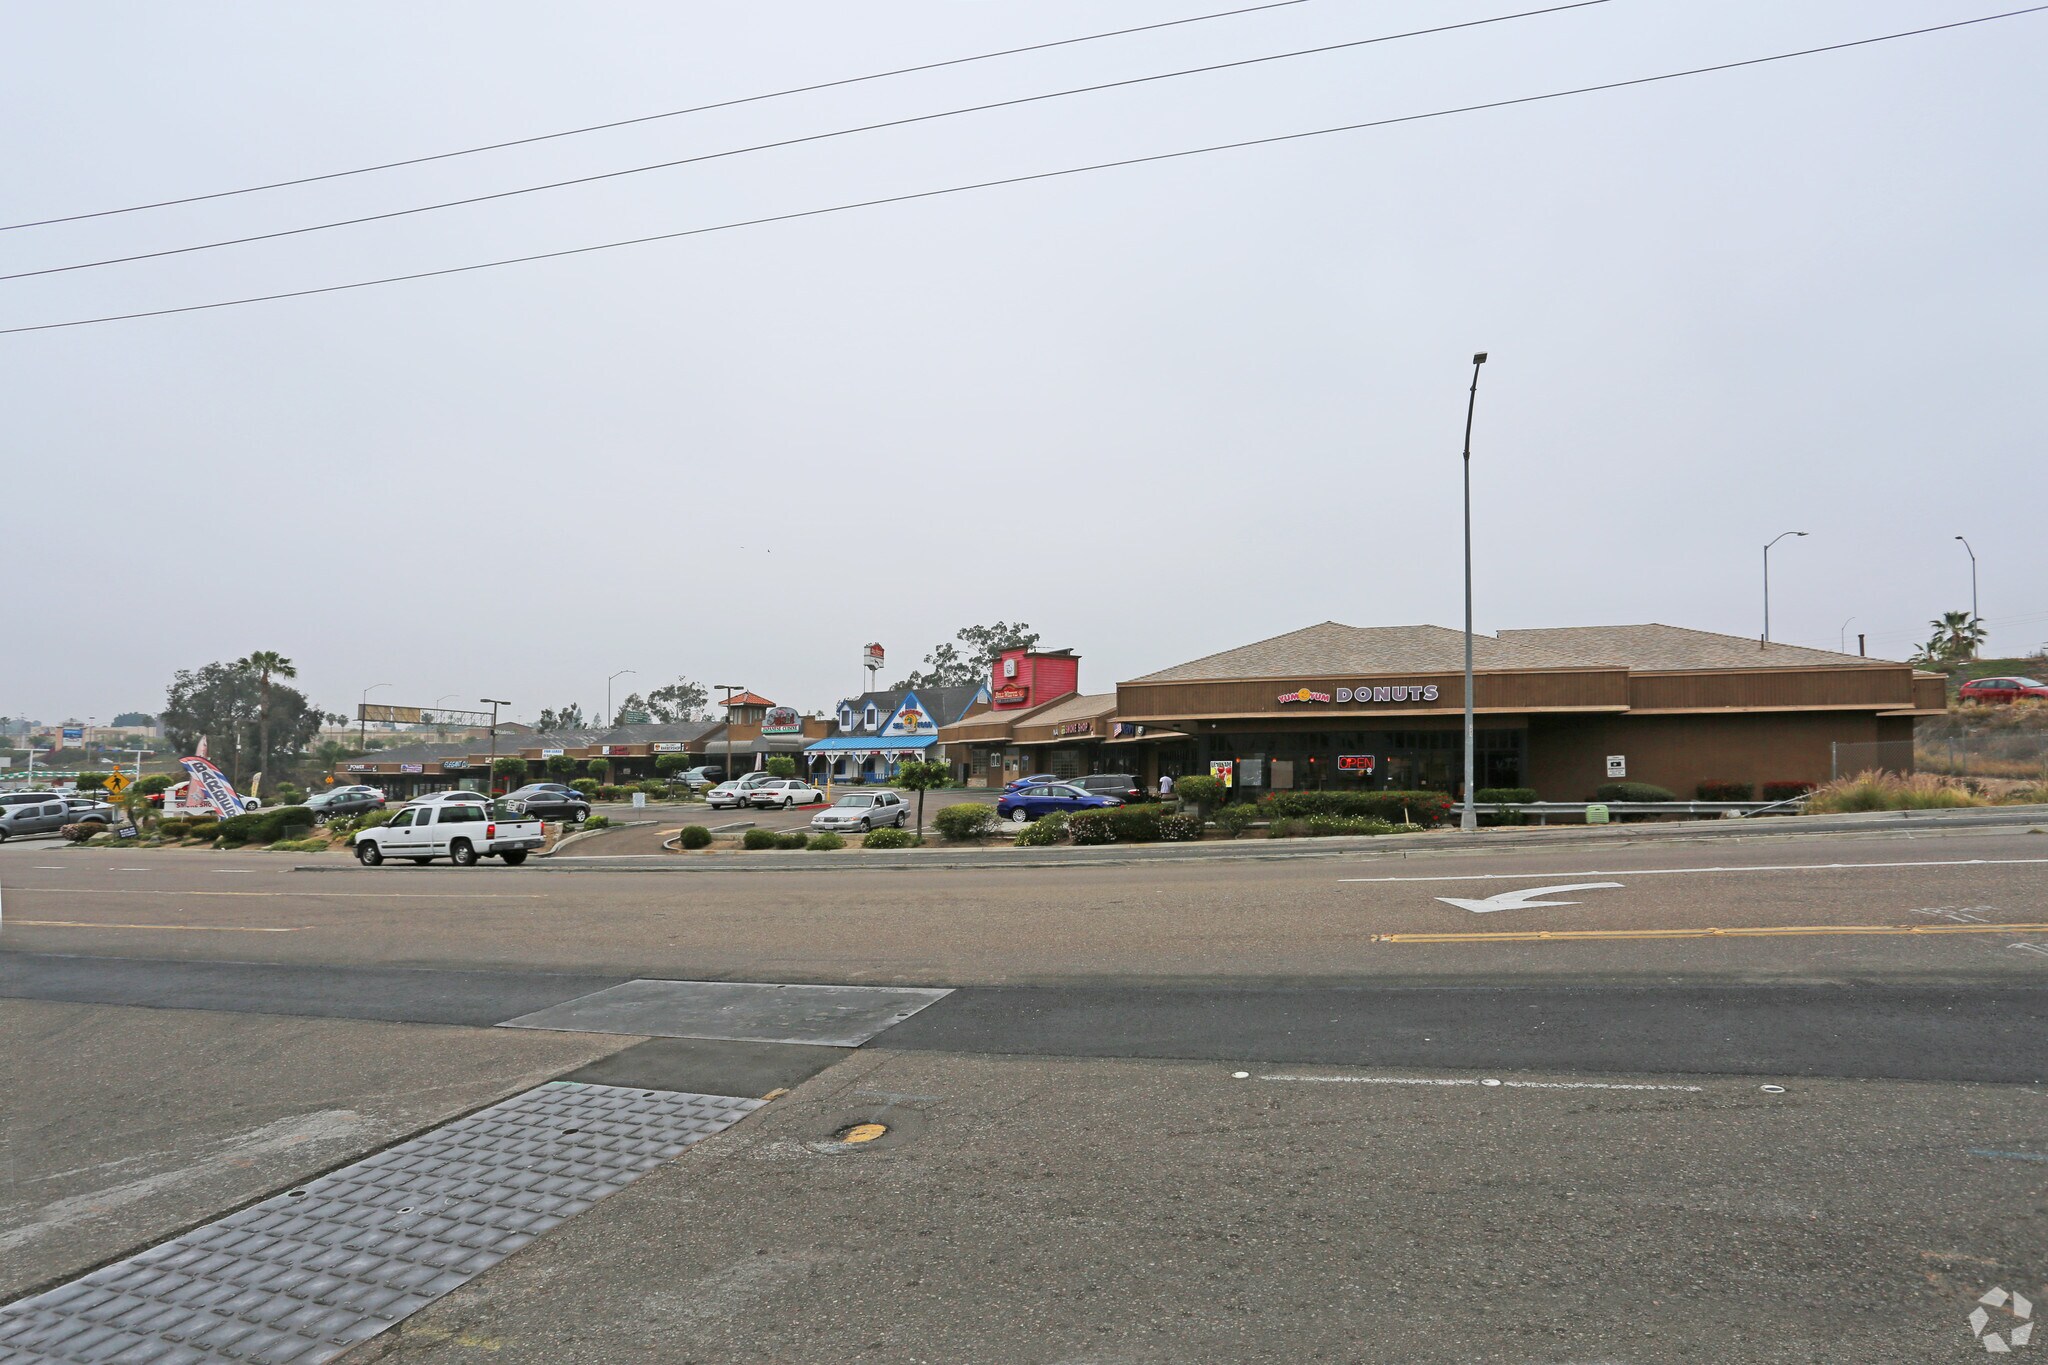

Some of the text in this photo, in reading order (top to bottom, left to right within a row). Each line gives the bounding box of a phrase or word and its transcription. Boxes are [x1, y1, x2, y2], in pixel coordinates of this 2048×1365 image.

[1277, 685, 1439, 704] YUM YUM DONUTS
[1340, 757, 1373, 769] OPEN
[192, 762, 236, 818] BARBER
